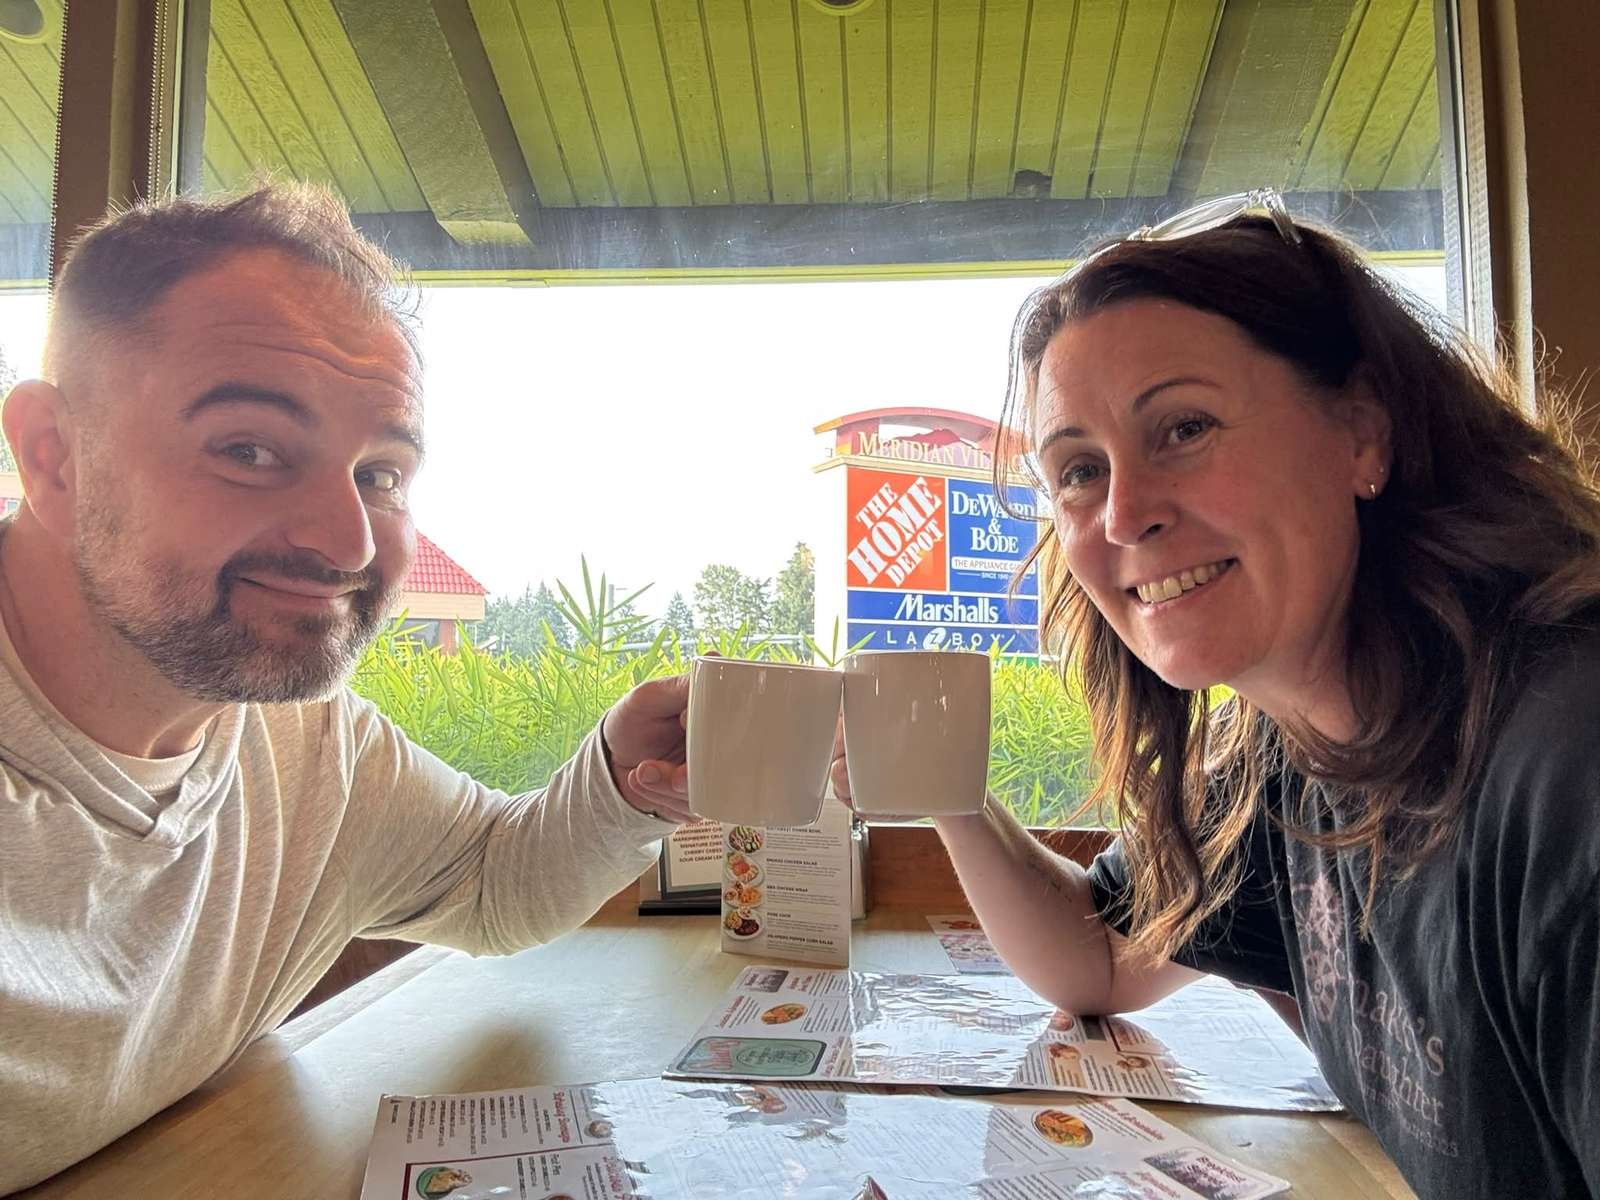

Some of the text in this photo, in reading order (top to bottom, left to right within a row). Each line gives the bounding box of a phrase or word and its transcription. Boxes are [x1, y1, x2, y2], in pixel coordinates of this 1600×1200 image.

[855, 481, 898, 530] THE
[847, 476, 942, 585] HOME
[988, 517, 1001, 535] &
[884, 518, 944, 588] DEPOT
[955, 559, 969, 568] THE
[969, 560, 1009, 571] APPLIANCE
[894, 593, 999, 624] Marshalls
